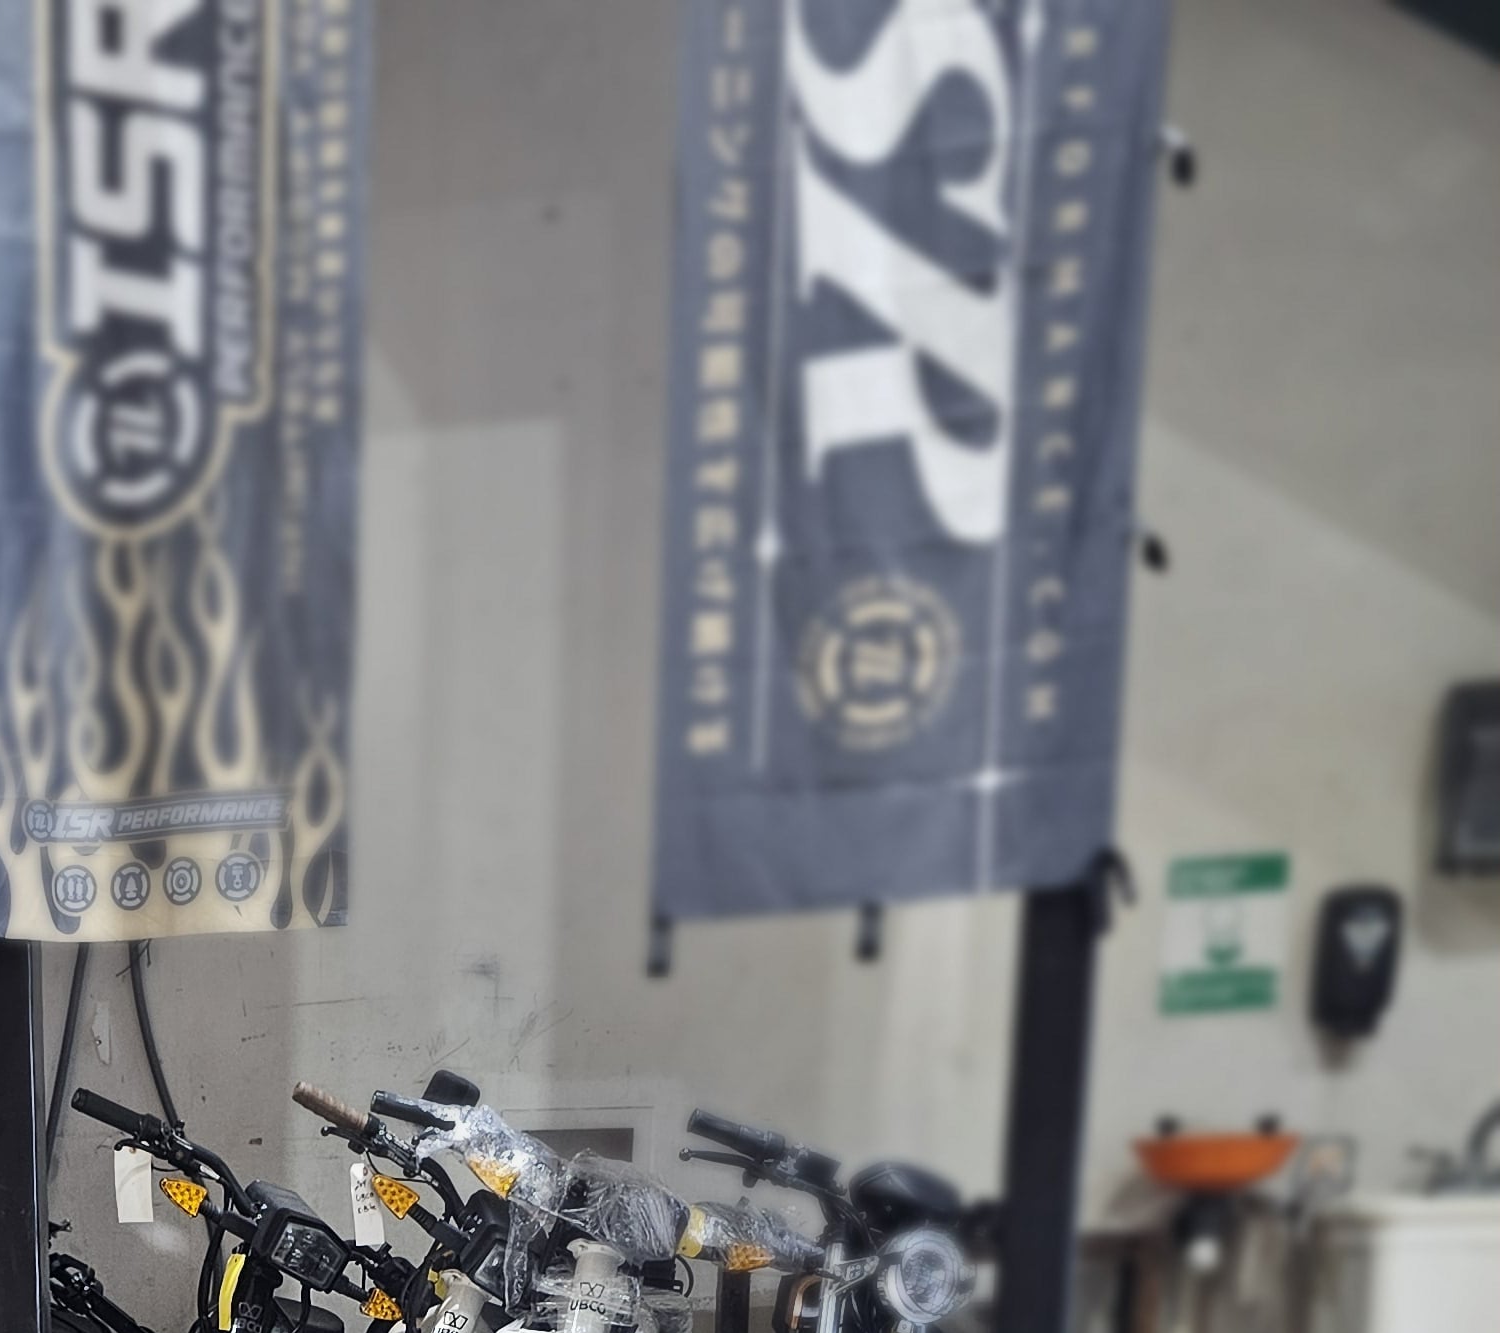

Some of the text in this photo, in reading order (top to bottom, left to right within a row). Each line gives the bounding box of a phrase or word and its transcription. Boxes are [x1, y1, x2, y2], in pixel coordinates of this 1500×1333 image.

[51, 799, 282, 839] ISR PERFORMANCE
[570, 1299, 606, 1315] UBCO
